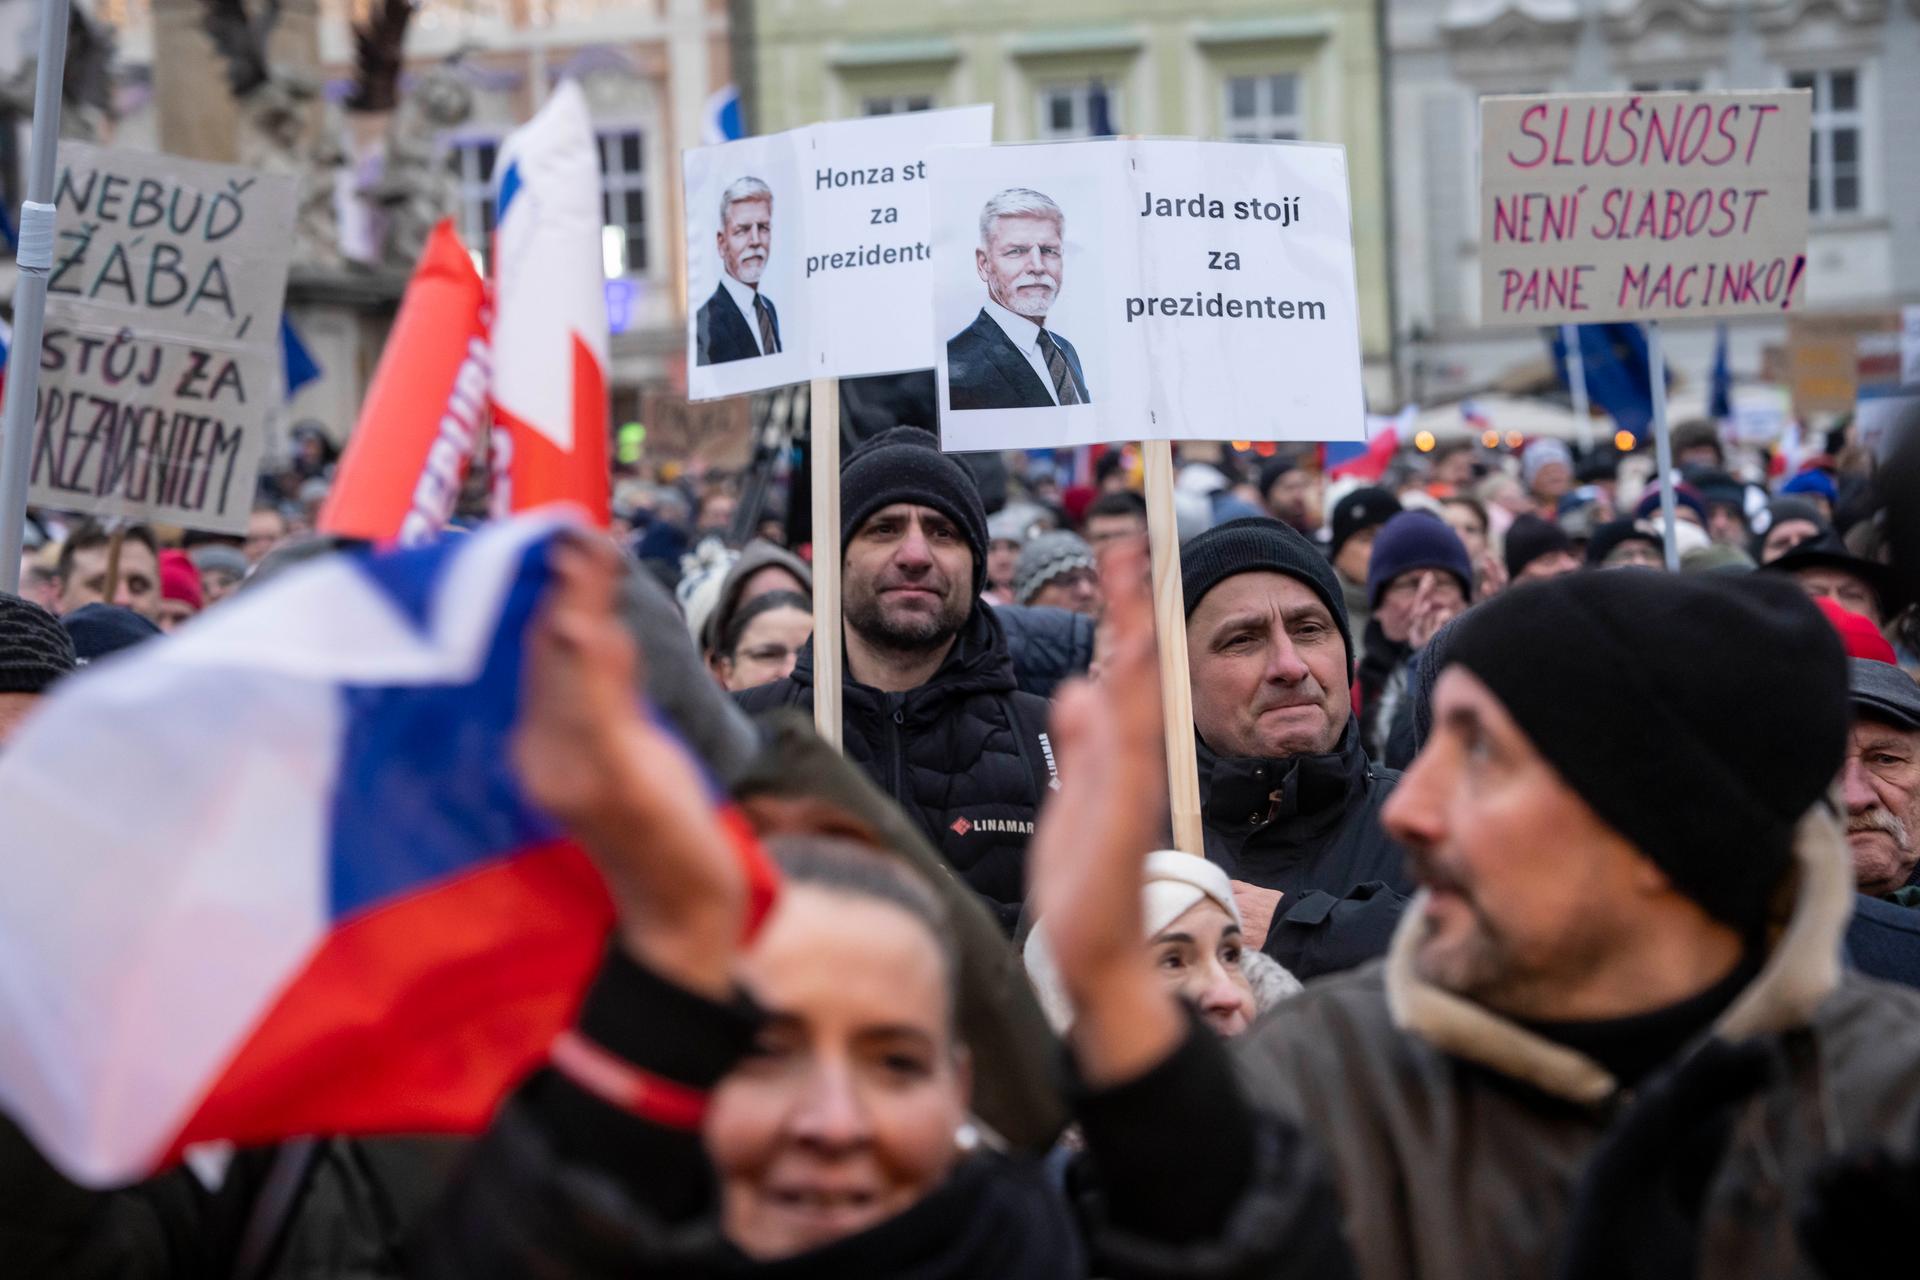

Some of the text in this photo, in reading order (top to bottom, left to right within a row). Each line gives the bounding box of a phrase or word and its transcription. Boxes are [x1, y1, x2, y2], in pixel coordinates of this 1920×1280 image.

[1508, 97, 1779, 167] SLUŠNOST
[816, 160, 926, 190] Honza st
[54, 166, 256, 242] NEBUĎ
[870, 206, 898, 225] za
[1141, 192, 1300, 227] Jarda stojí
[1494, 184, 1769, 243] NENÍ SLABOST
[47, 222, 252, 338] ŽÁBA,
[1208, 251, 1241, 271] za
[1499, 254, 1806, 313] PANE MACINKO!
[1126, 292, 1326, 322] prezidentem
[40, 327, 246, 404] STŮJ ZA
[973, 819, 1035, 834] LINAMAR
